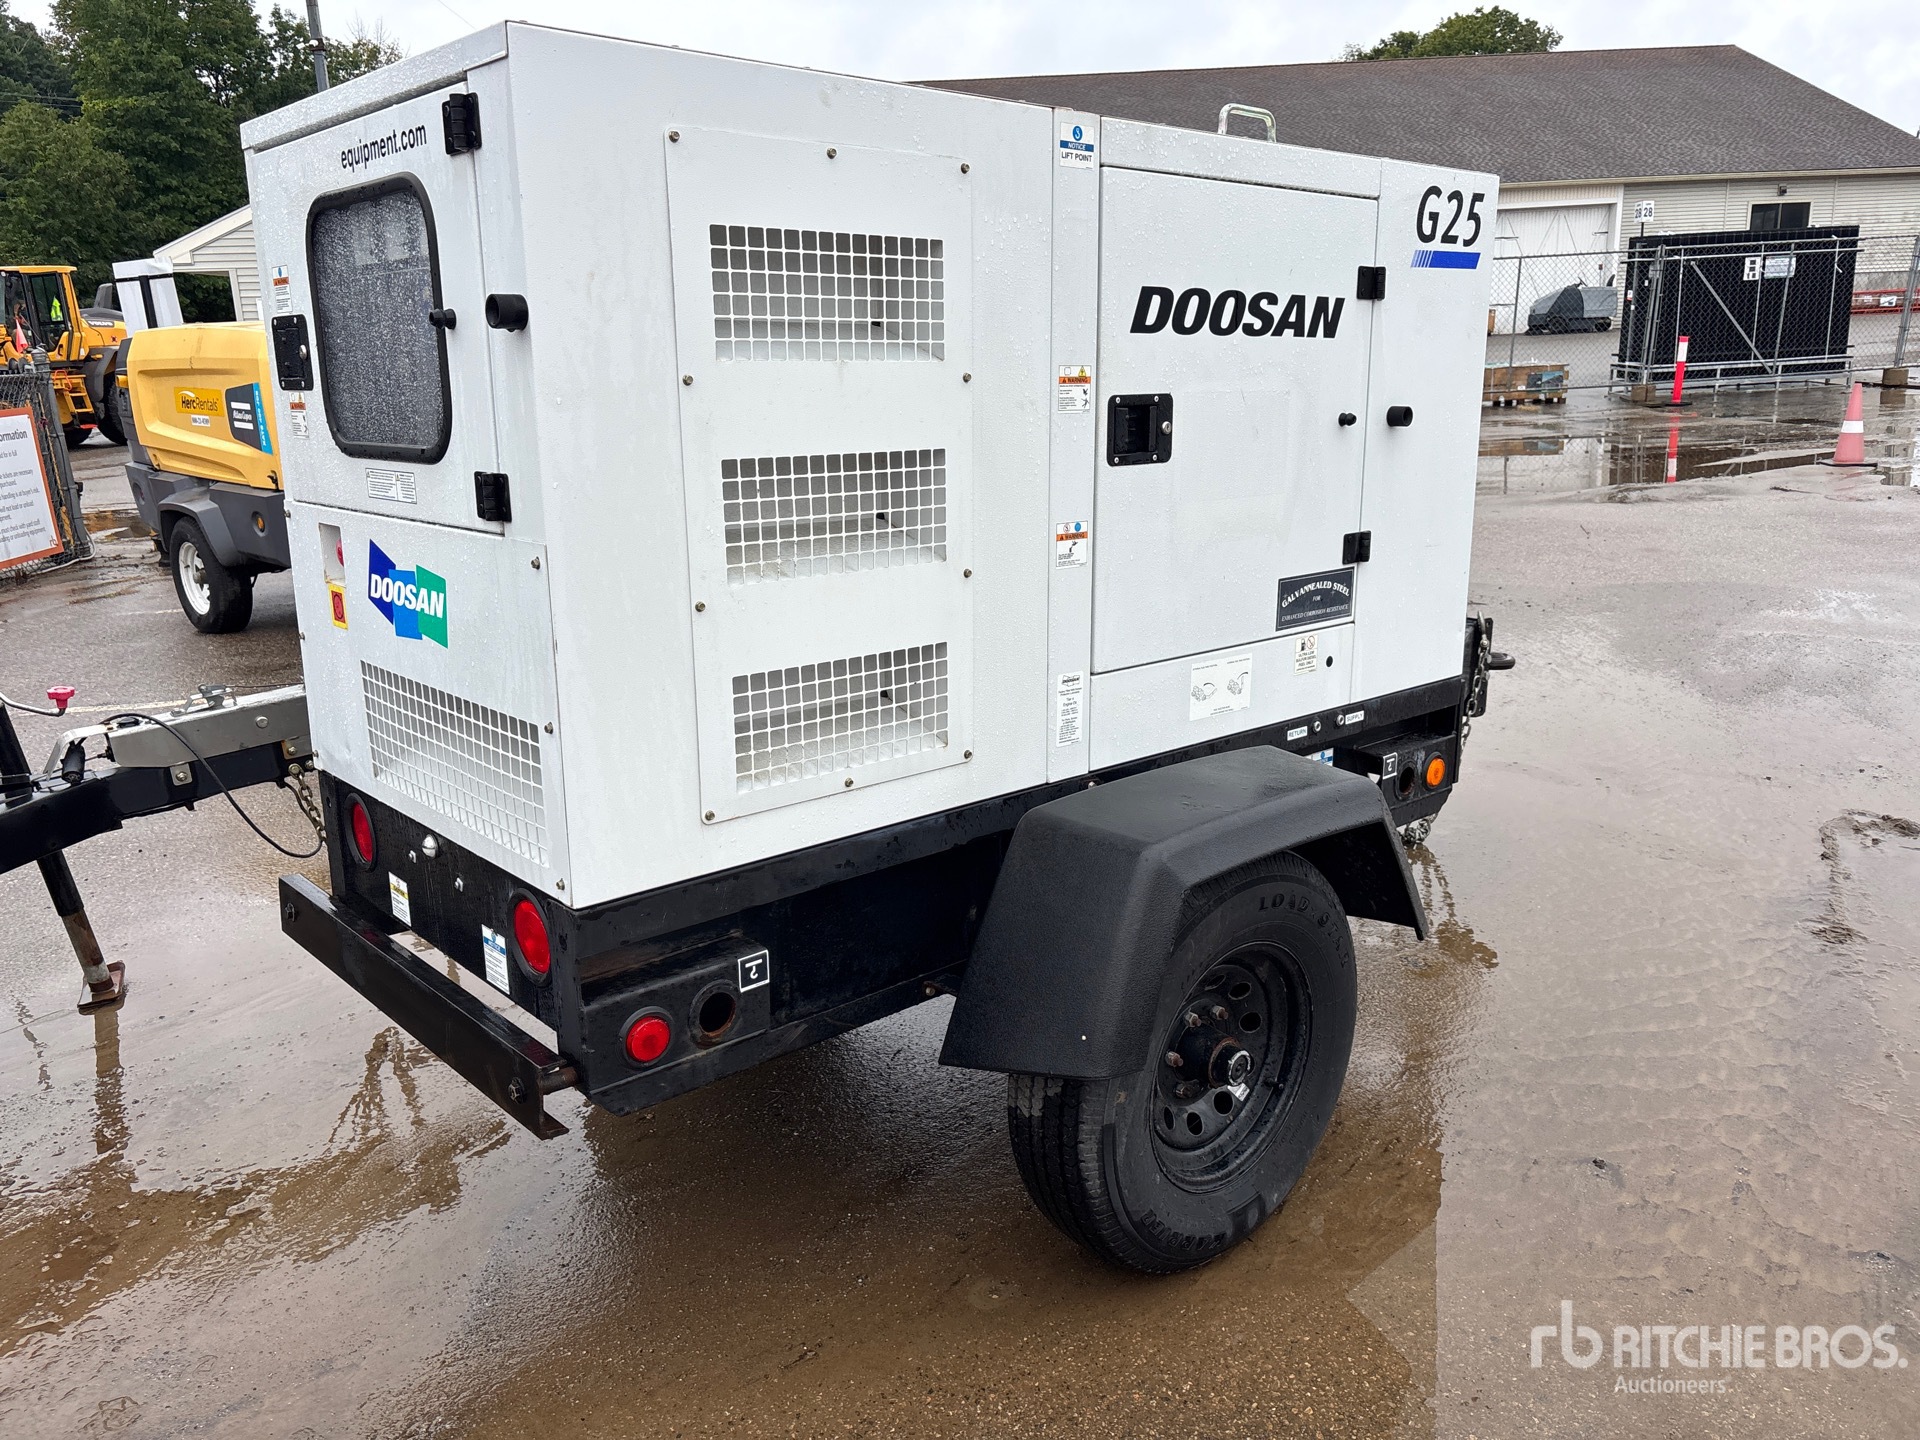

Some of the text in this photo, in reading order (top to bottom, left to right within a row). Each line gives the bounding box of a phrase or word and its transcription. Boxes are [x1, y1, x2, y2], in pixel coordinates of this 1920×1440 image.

[341, 125, 427, 173] equipment.com
[1068, 143, 1086, 151] NOTICE
[1061, 151, 1092, 162] LIFT POINT
[1417, 185, 1485, 247] G25
[1644, 207, 1653, 217] 28
[1130, 286, 1345, 338] DOOSAN
[371, 573, 444, 618] DOOSAN
[1282, 581, 1349, 608] GALVANNEALED STEEL
[1281, 604, 1349, 622] ENHANCED CORROSION RESISTANCE
[1346, 713, 1364, 722] SUPPLY
[1288, 728, 1306, 738] RETURN
[1259, 893, 1310, 912] LOAD
